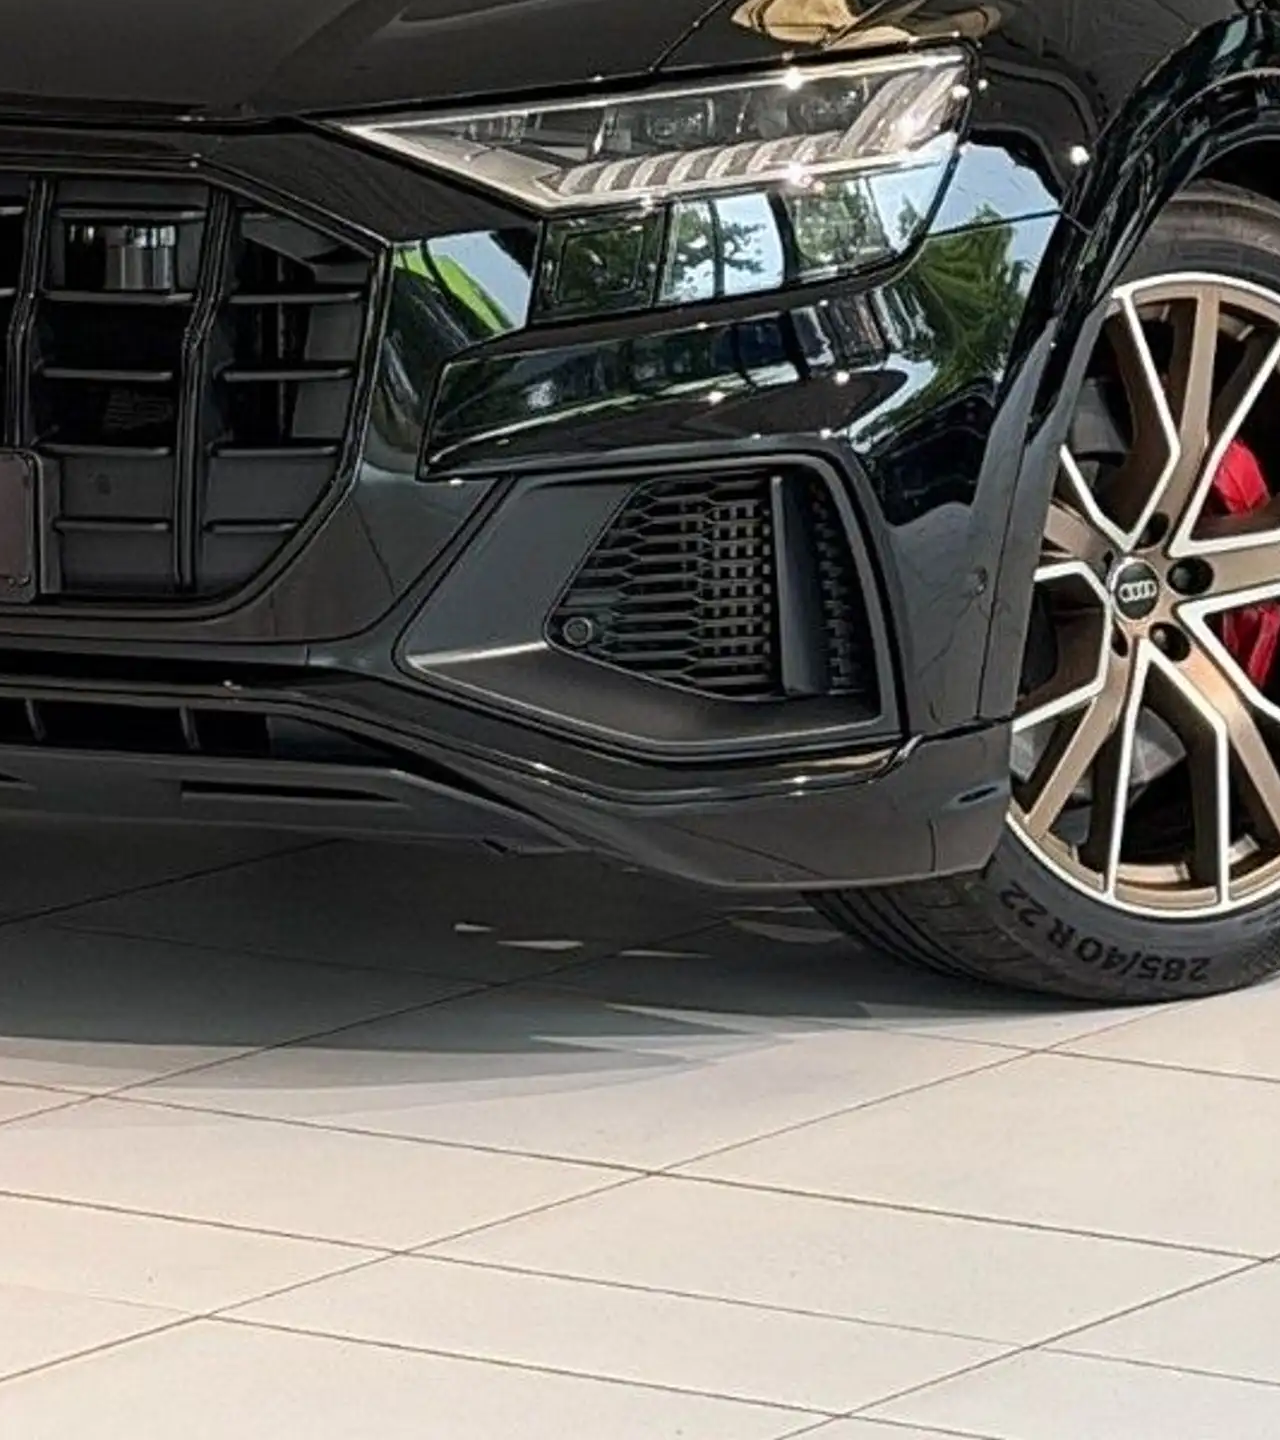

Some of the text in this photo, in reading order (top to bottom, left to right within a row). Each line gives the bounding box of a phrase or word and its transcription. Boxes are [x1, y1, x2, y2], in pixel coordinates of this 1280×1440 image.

[1000, 879, 1212, 983] 285/40 R 22
